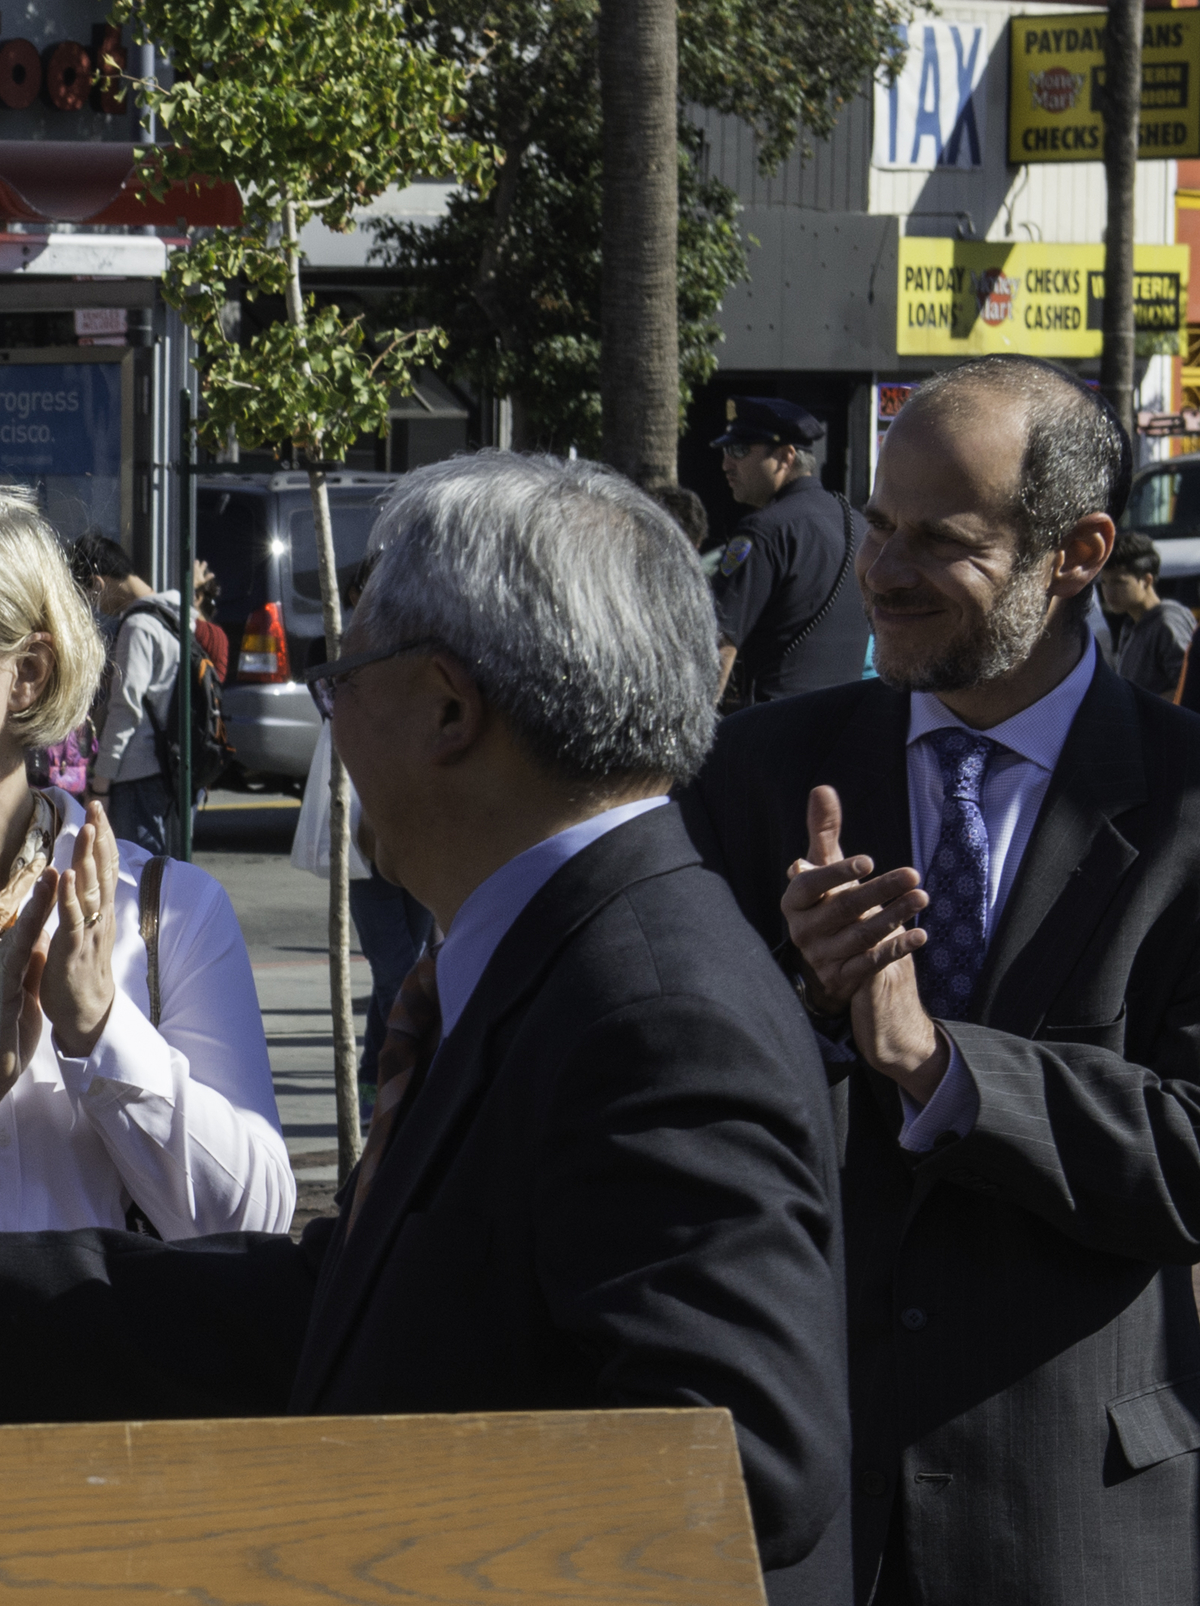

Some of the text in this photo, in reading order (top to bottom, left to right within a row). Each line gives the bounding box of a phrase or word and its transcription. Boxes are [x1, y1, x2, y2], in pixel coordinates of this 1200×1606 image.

[882, 23, 982, 165] TAX
[1022, 126, 1100, 151] CHECKS
[905, 266, 965, 292] PAYDAY
[1025, 268, 1080, 295] CHECKS
[908, 303, 958, 329] LOANS
[1024, 303, 1081, 331] CASHED
